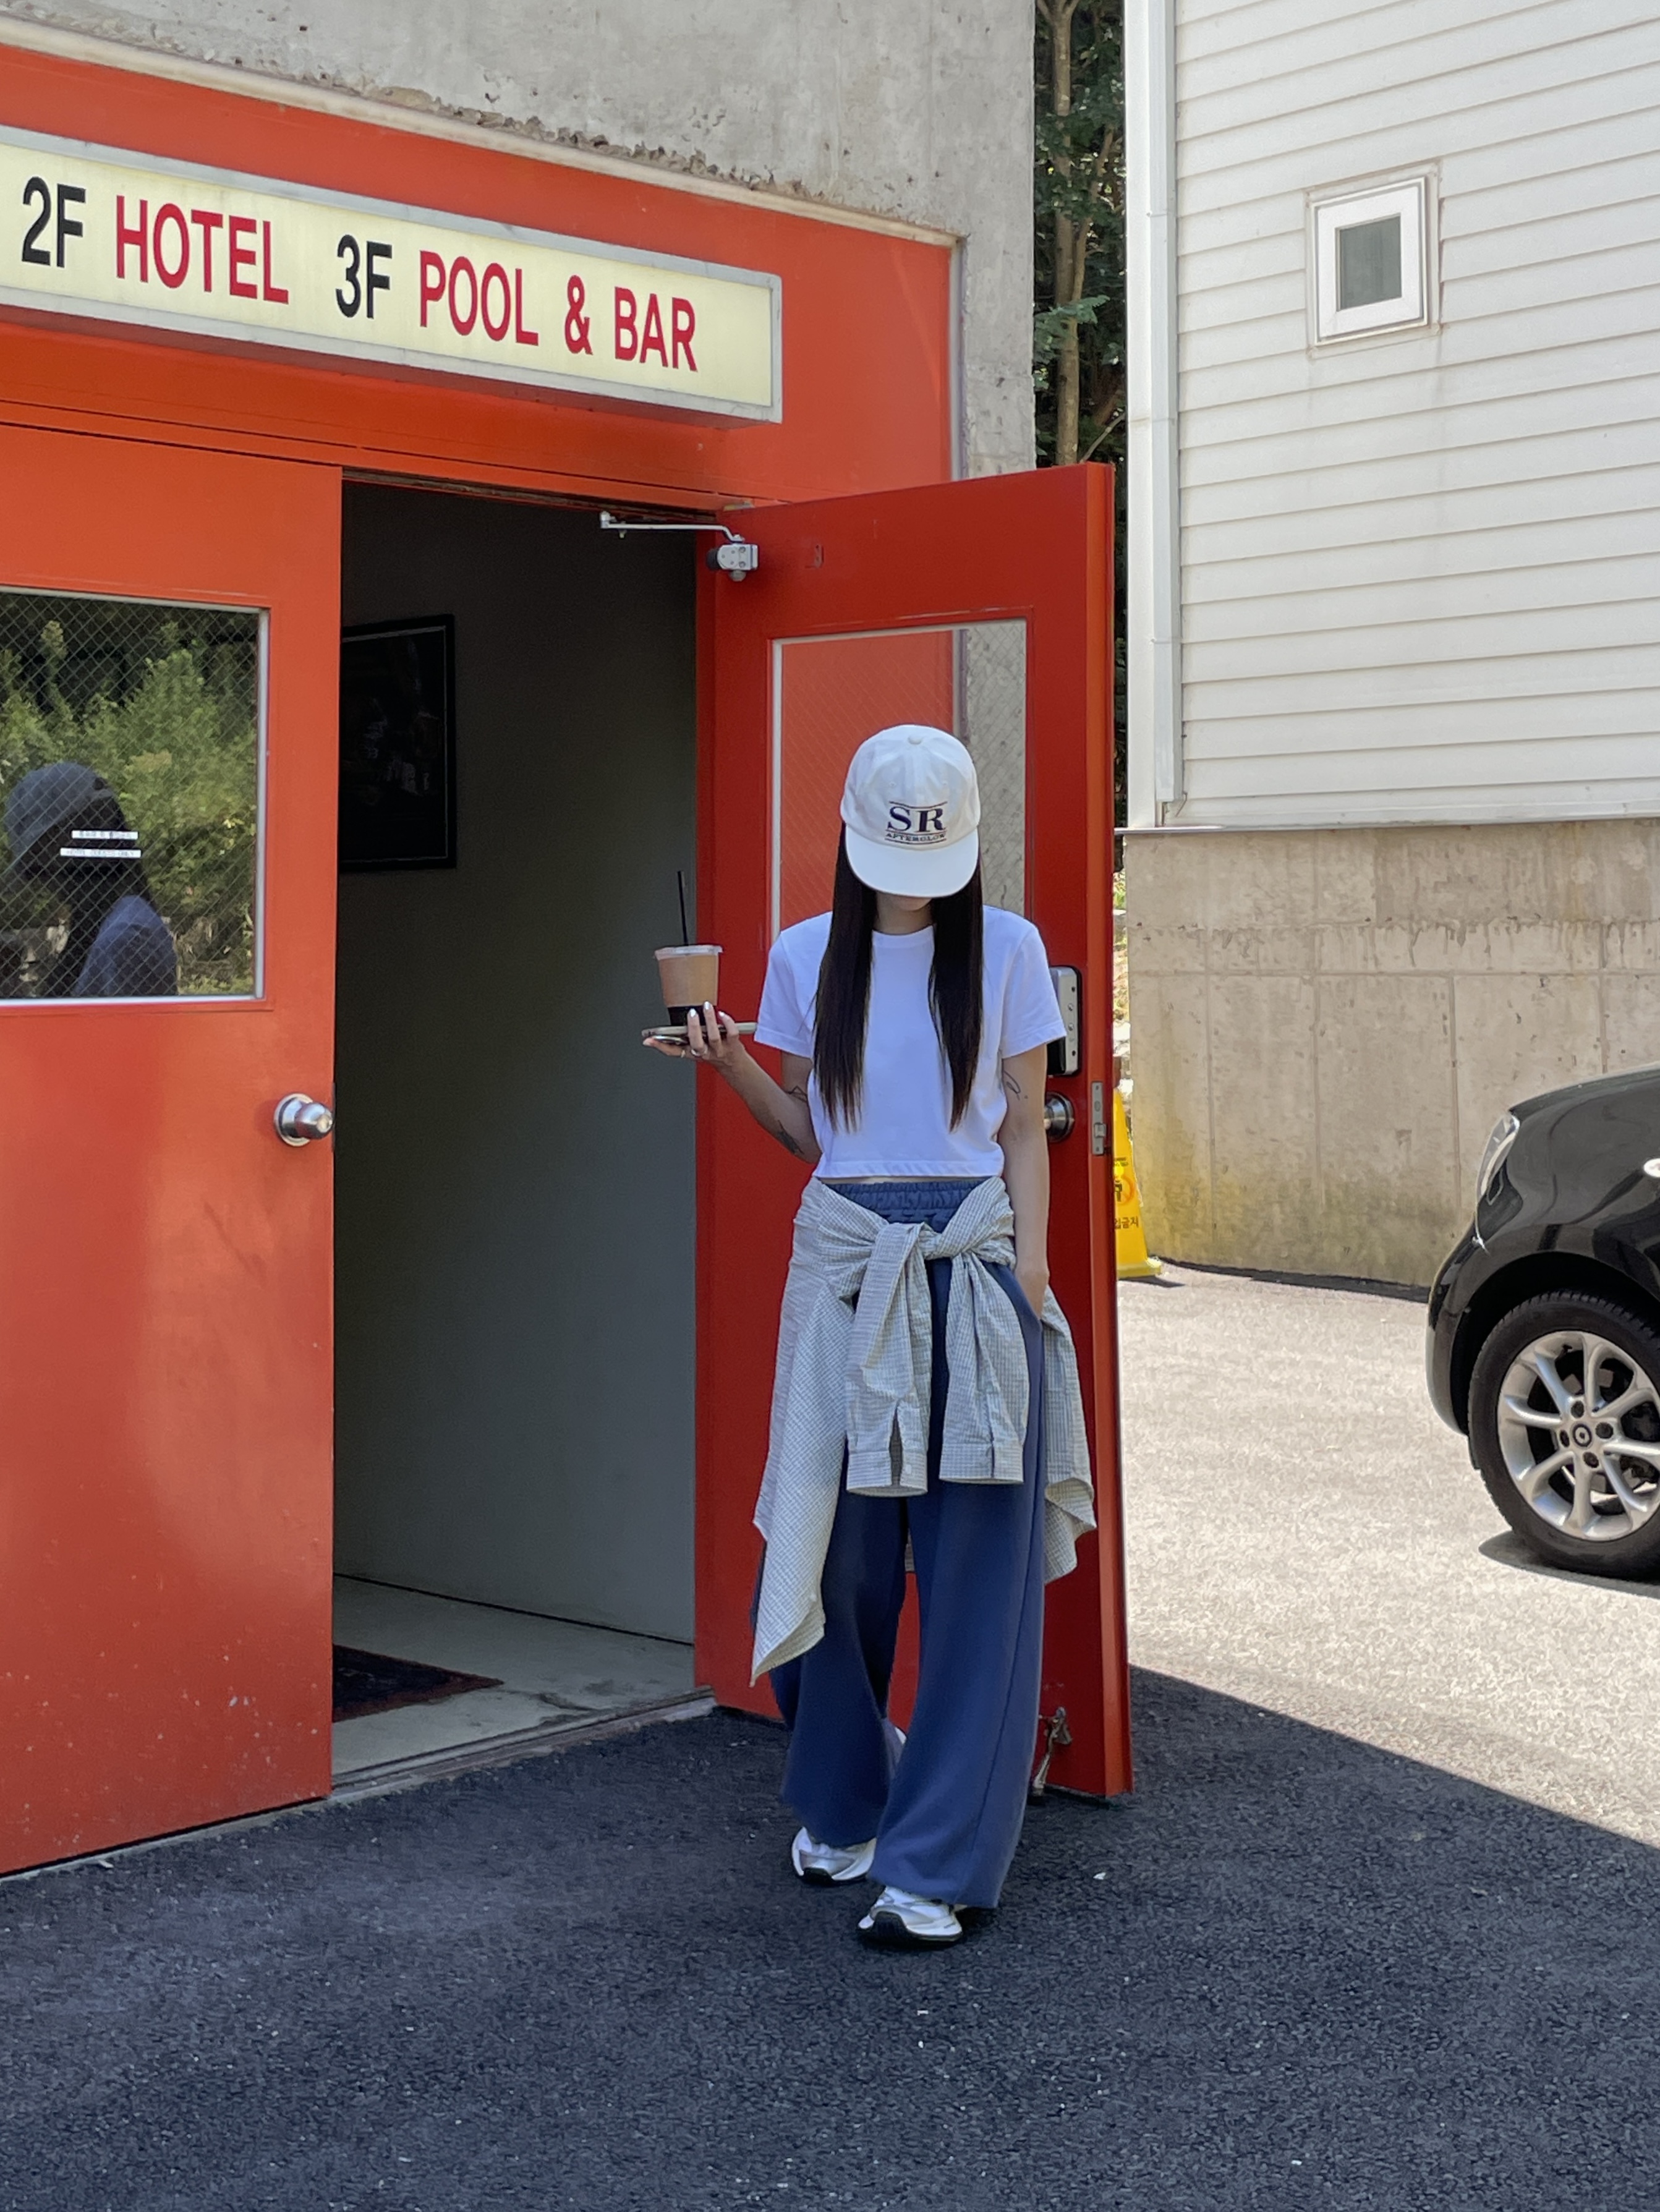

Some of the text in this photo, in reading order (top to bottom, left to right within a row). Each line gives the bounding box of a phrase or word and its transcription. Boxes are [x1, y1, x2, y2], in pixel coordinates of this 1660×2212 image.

[21, 176, 698, 372] 2F HOTEL 3F POOL & BAR
[887, 806, 947, 833] SR
[1115, 1215, 1139, 1229] 입금지
